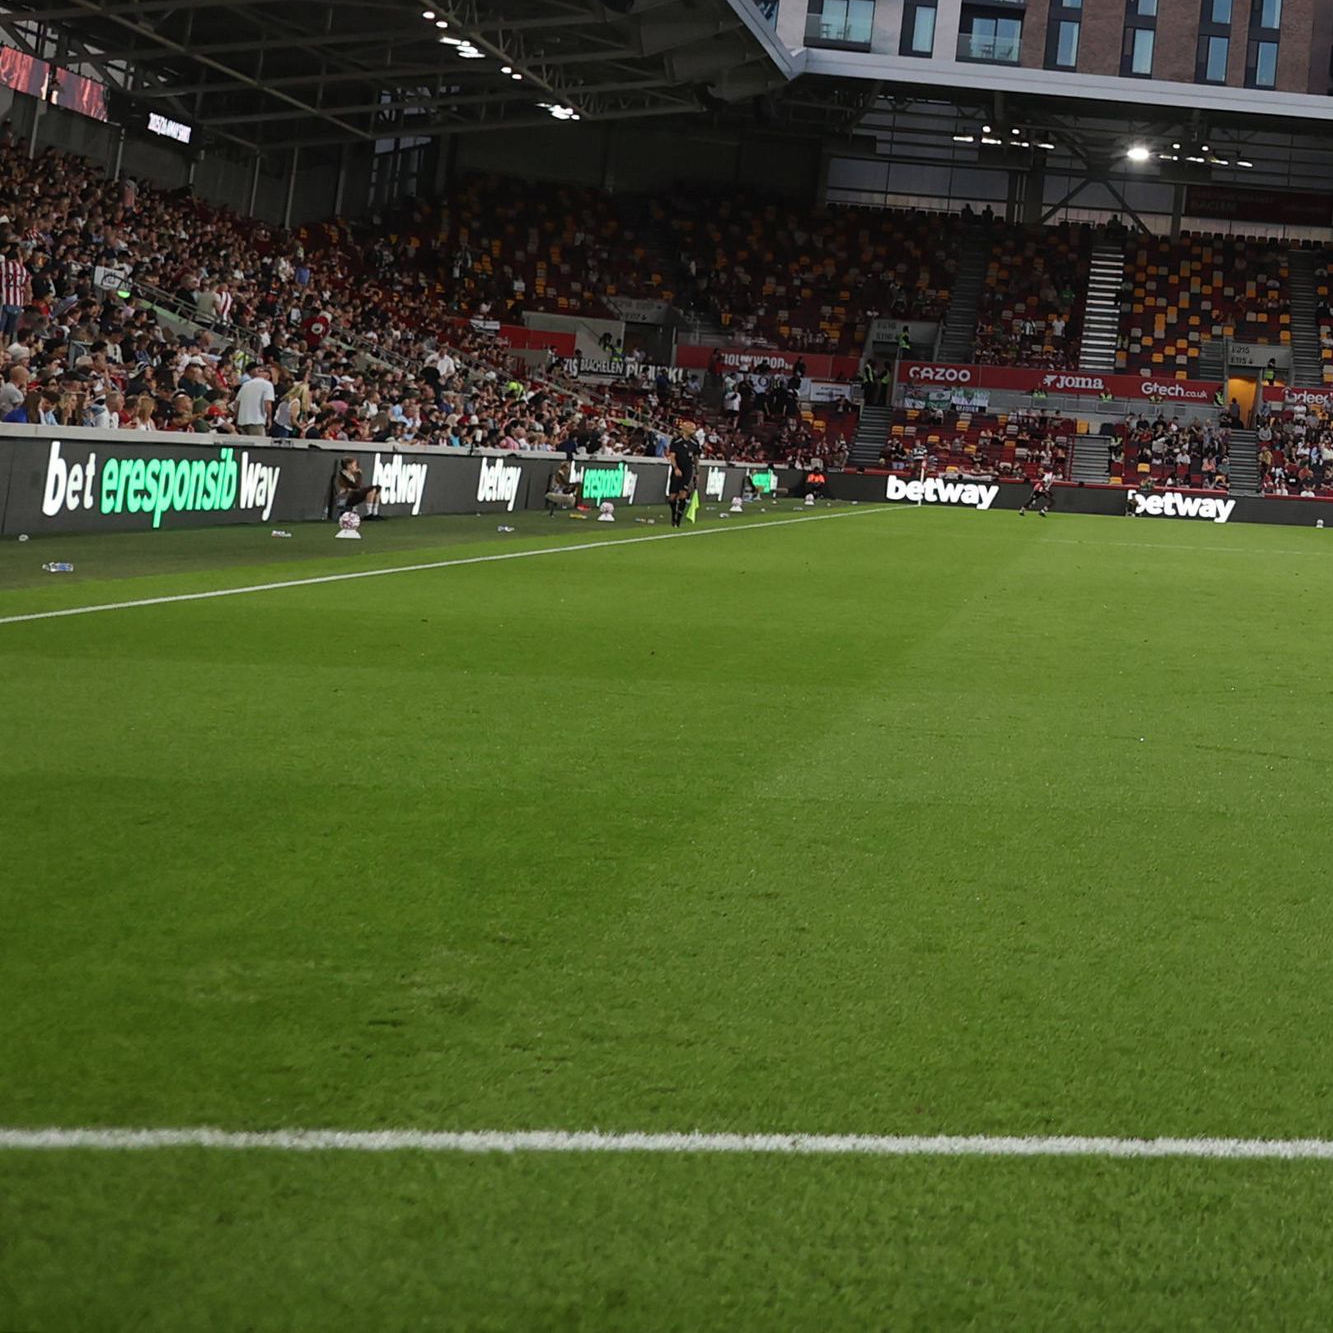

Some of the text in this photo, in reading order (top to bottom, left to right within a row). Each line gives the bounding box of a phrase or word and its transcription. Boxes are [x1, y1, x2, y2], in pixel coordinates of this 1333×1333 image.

[908, 366, 972, 383] CAZOO
[1140, 381, 1208, 399] Gtech.co.uk
[42, 441, 96, 516] bet
[101, 447, 238, 529] eresponsib
[371, 453, 428, 516] betway
[476, 457, 522, 512] betway
[886, 474, 1000, 510] betway
[1127, 489, 1236, 523] betway
